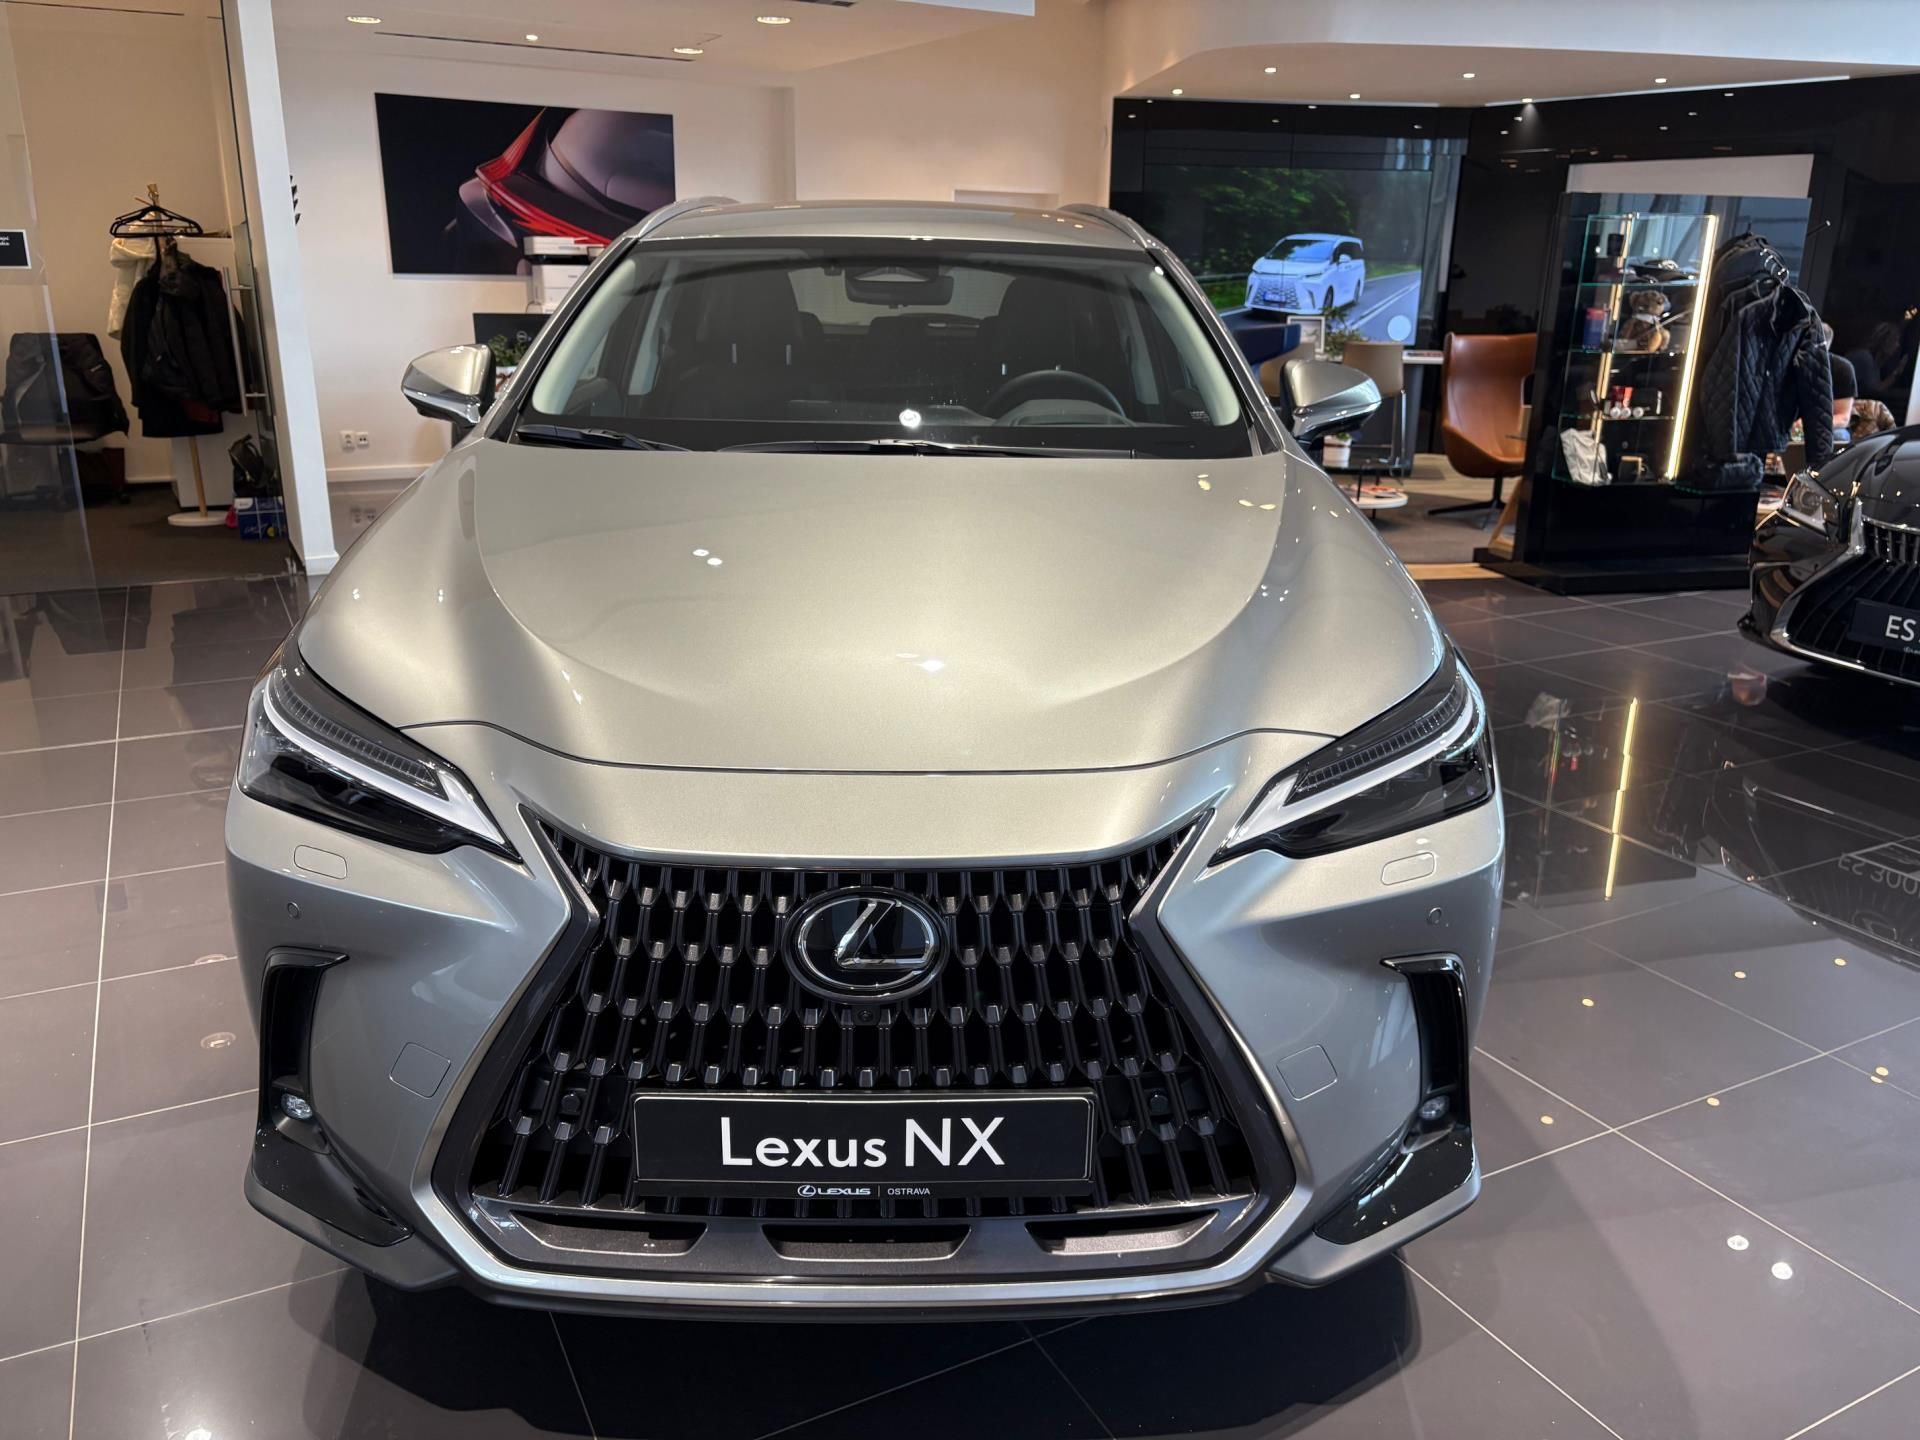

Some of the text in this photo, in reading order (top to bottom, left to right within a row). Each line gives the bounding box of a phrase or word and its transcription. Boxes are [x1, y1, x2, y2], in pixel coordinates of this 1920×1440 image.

[1885, 614, 1917, 642] ES
[720, 1116, 1005, 1168] Lexus NX
[817, 1187, 931, 1196] LEXUS OSTRAVA
